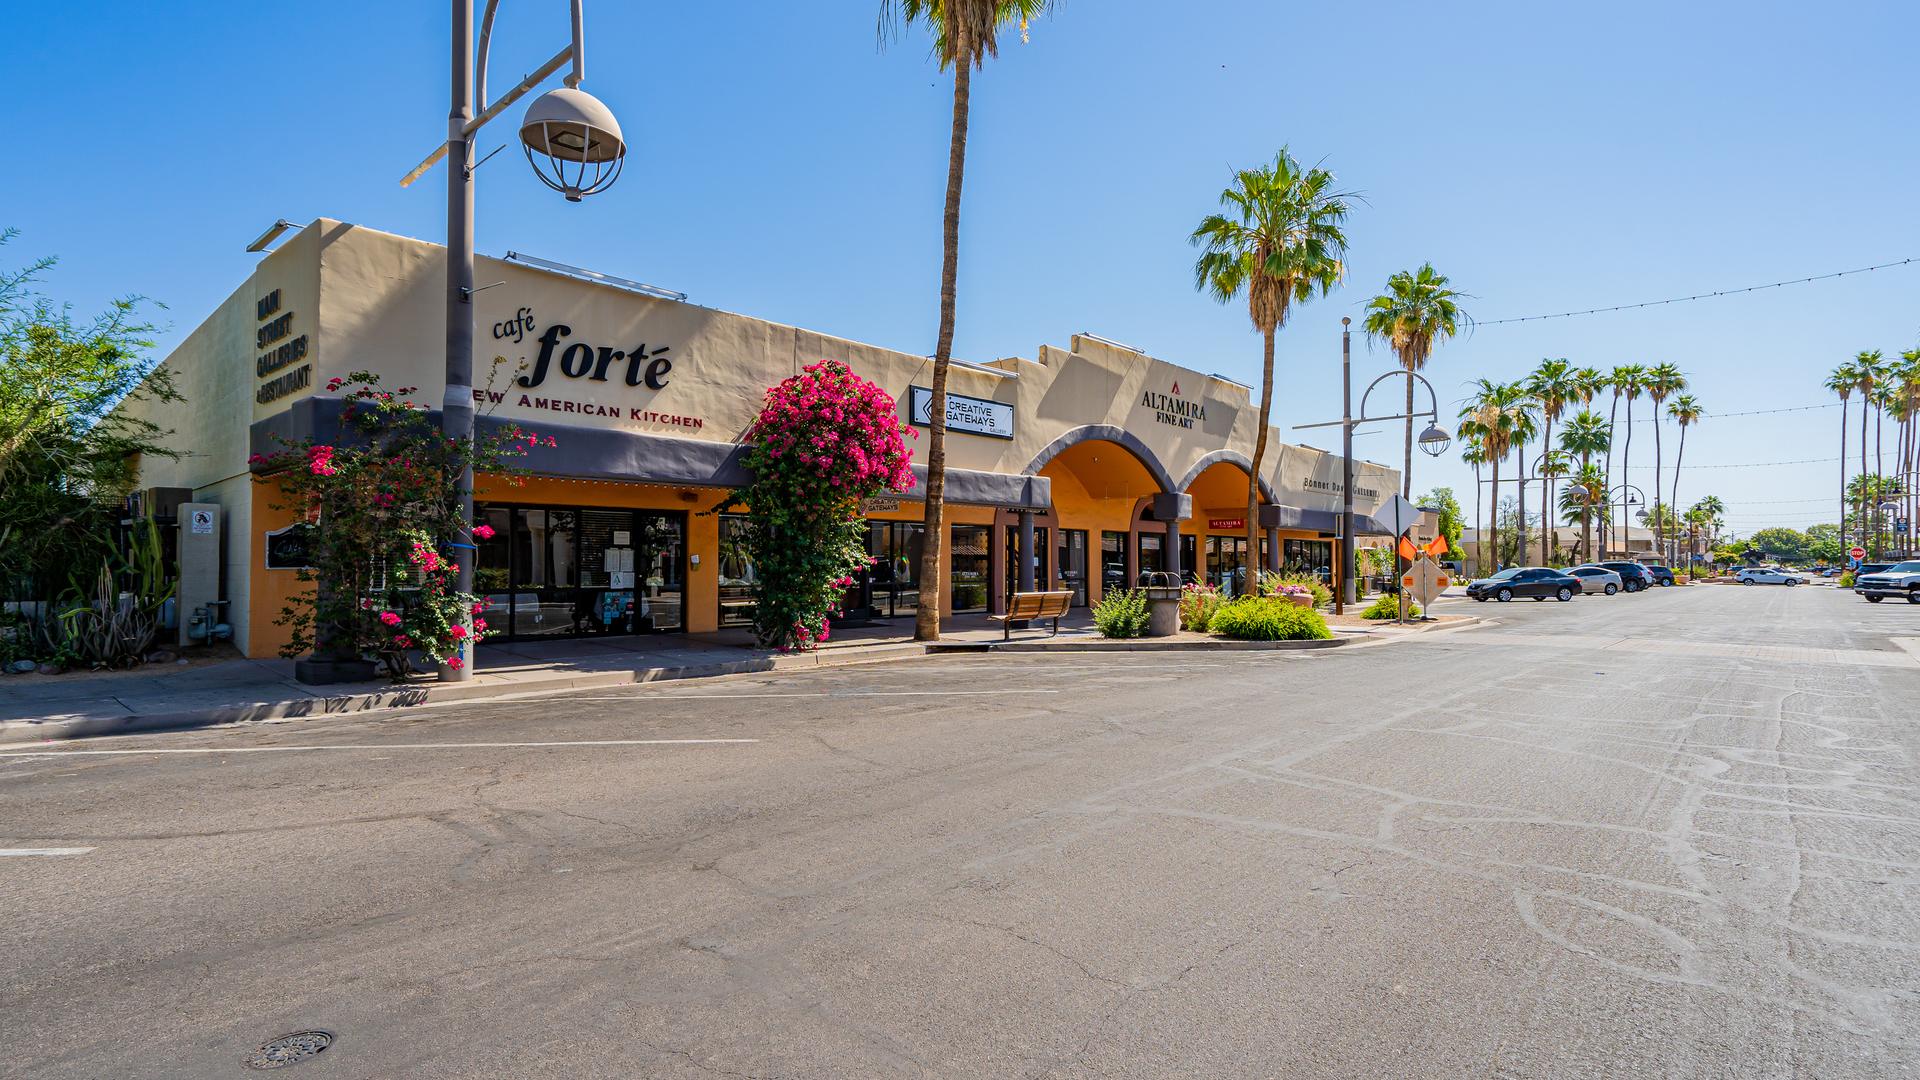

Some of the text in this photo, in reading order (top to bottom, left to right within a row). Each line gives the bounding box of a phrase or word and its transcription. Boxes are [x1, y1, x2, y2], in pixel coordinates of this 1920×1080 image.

[257, 288, 281, 321] MAIN
[257, 311, 294, 349] STREET
[493, 307, 536, 343] café
[257, 334, 309, 378] GALLERIES
[517, 324, 672, 390] forté
[472, 389, 703, 429] EW AMERICAN KITCHEN
[945, 411, 995, 427] GATEWAYS
[948, 401, 992, 417] CREATIVE
[1141, 390, 1207, 421] ALTAMIRA
[1156, 411, 1194, 430] FINE ART
